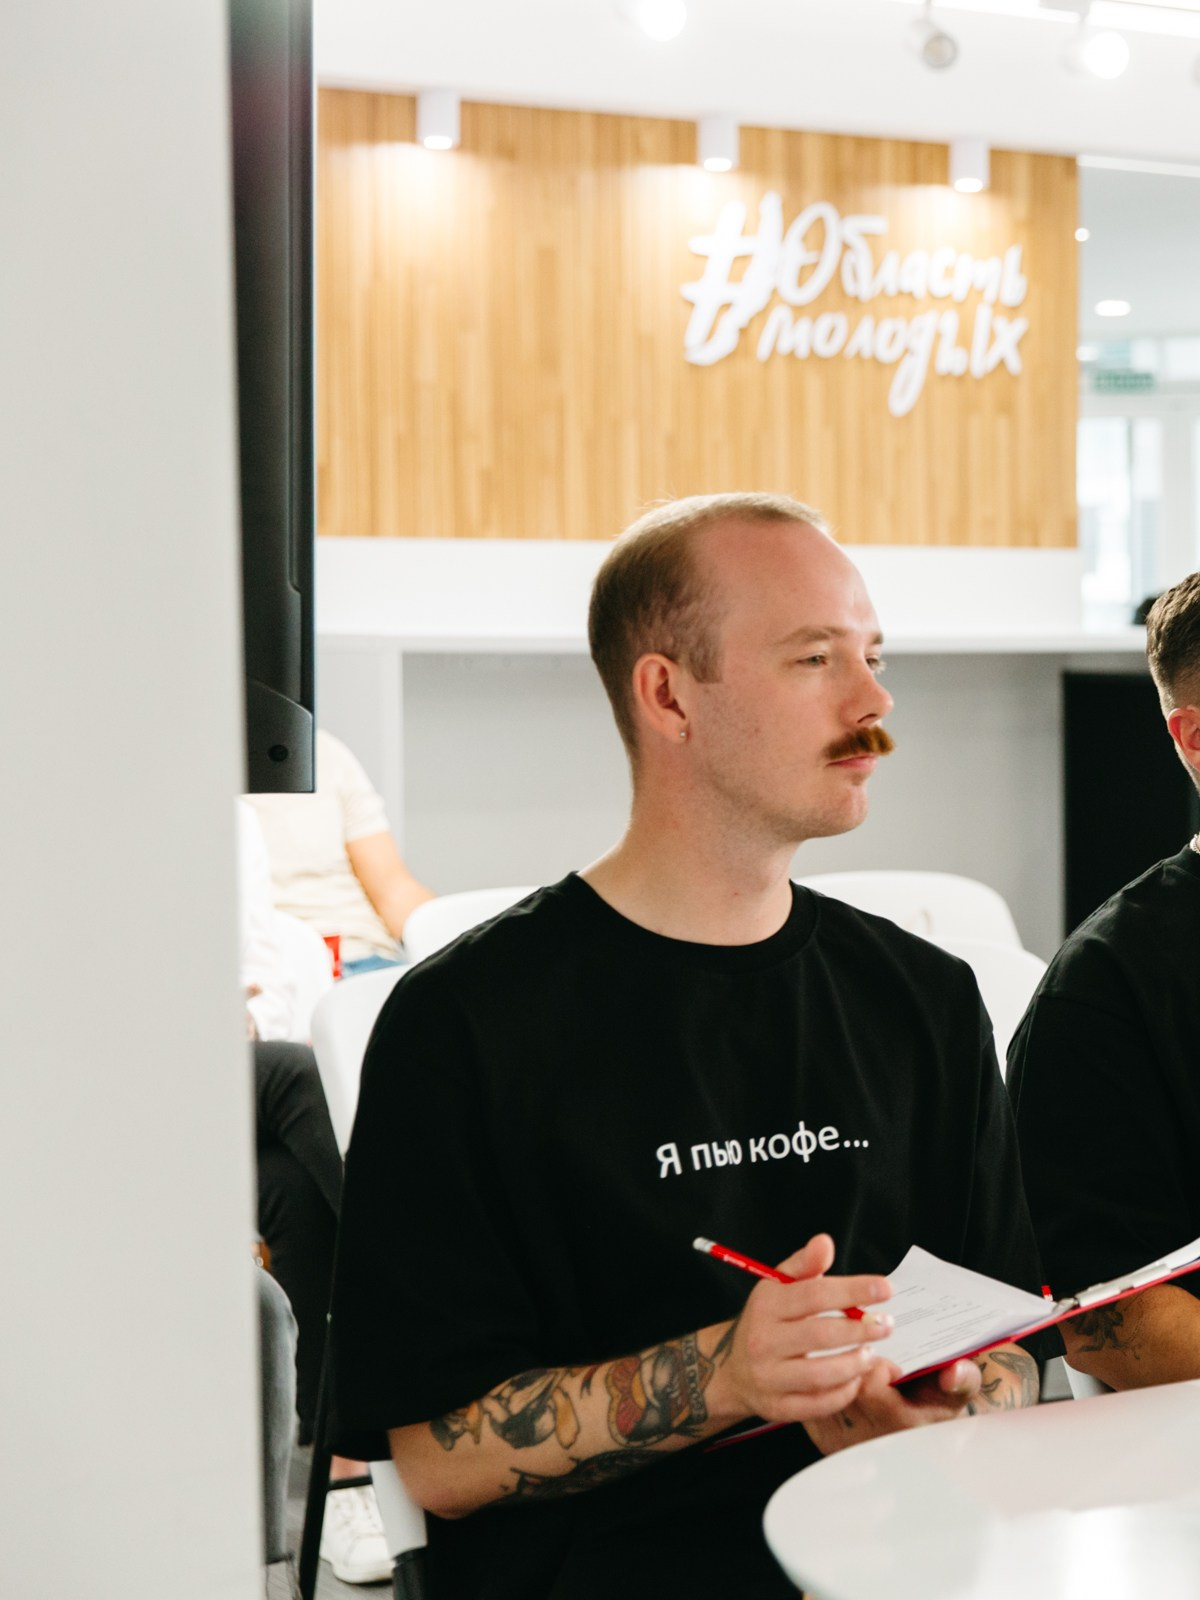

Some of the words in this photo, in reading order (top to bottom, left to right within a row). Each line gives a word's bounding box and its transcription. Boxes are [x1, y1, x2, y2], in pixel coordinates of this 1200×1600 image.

[680, 190, 1027, 365] #Область
[757, 303, 1028, 417] молодых
[656, 1142, 683, 1179] Я
[690, 1139, 743, 1171] пью
[749, 1120, 869, 1163] кофе...
